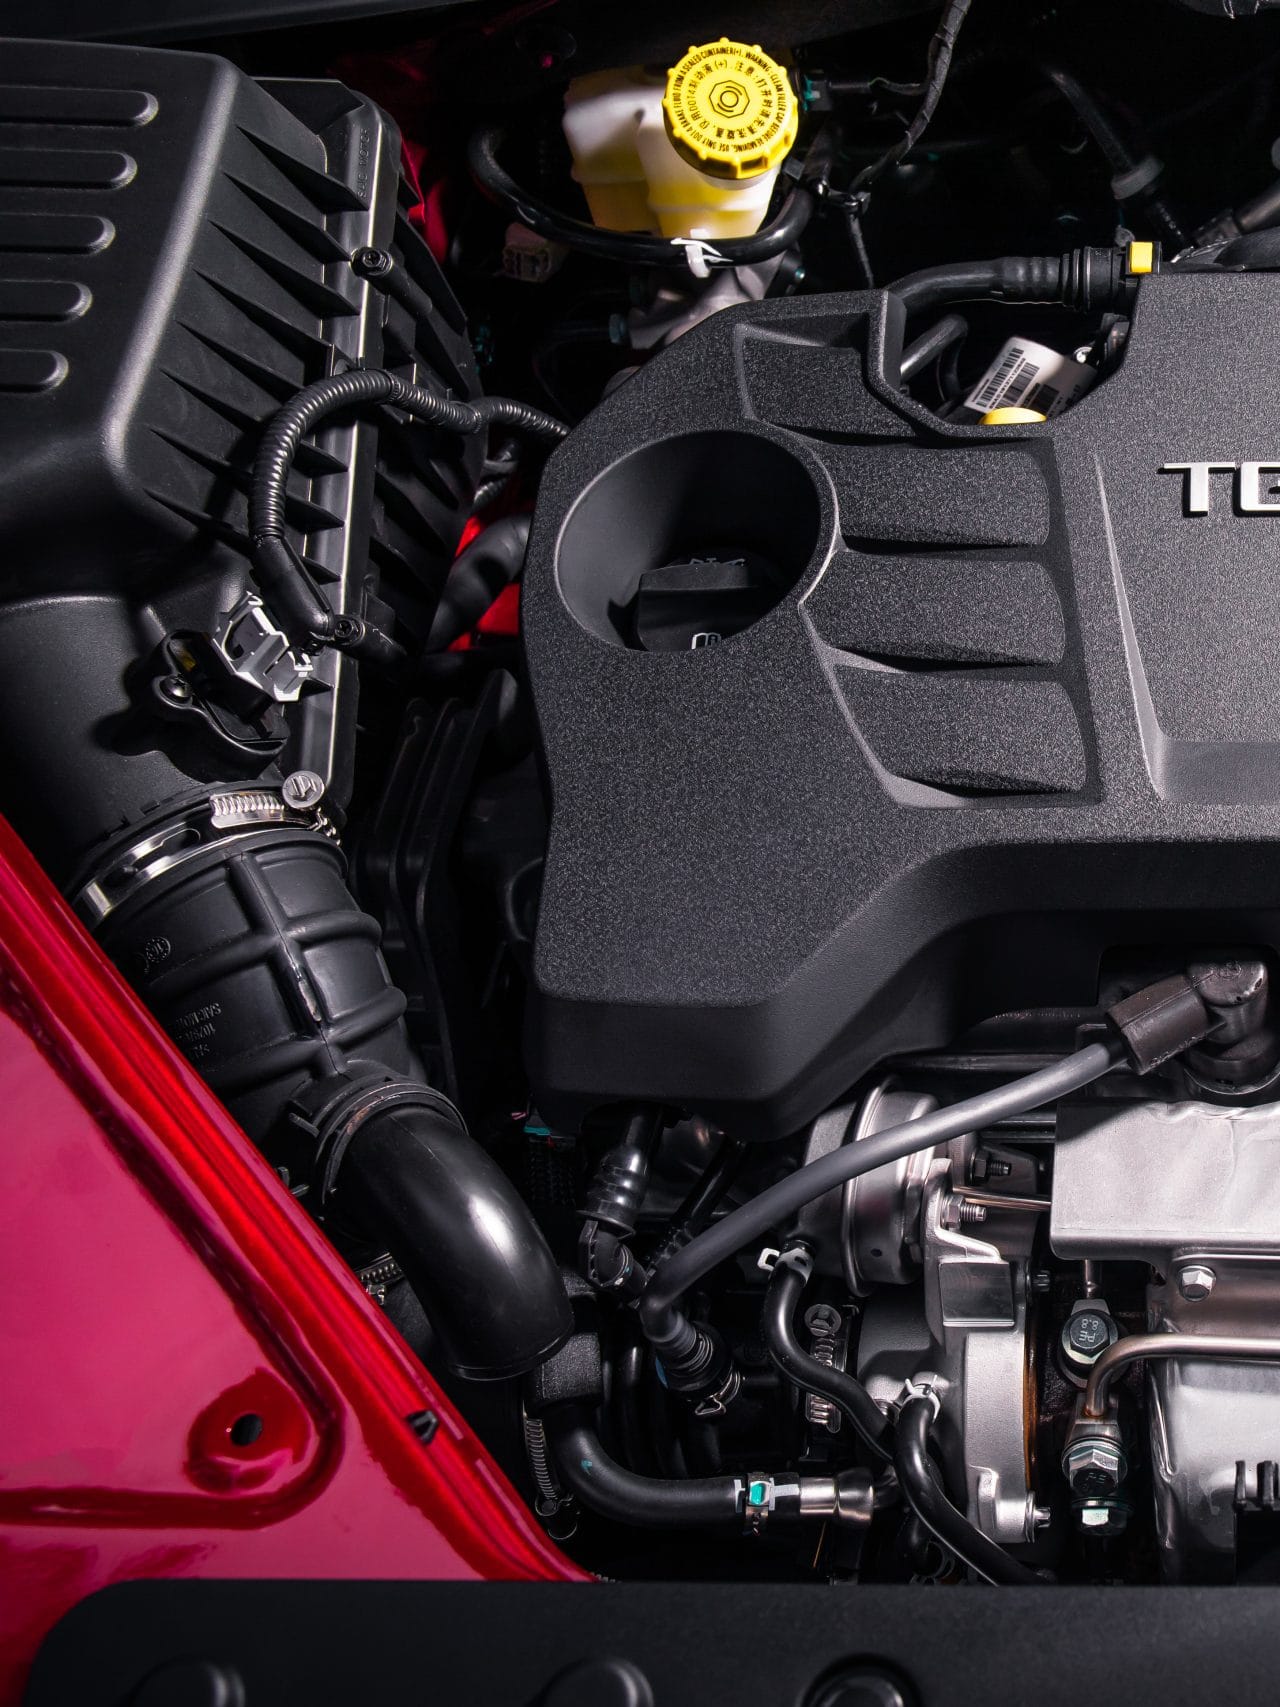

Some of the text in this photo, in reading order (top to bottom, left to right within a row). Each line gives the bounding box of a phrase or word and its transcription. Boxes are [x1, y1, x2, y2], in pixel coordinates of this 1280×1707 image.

[682, 54, 702, 71] SEALED
[745, 52, 772, 72] WARNING
[673, 74, 684, 91] FROM
[770, 74, 784, 92] CLEAN
[672, 92, 681, 108] FLUID
[777, 94, 786, 111] FILLER
[675, 109, 690, 128] BRAKE
[775, 112, 784, 123] CAP
[762, 122, 780, 141] BEFORE
[702, 138, 716, 149] ONLY
[719, 143, 729, 152] USE
[1081, 1318, 1099, 1331] 8.8
[1078, 1330, 1097, 1343] PE
